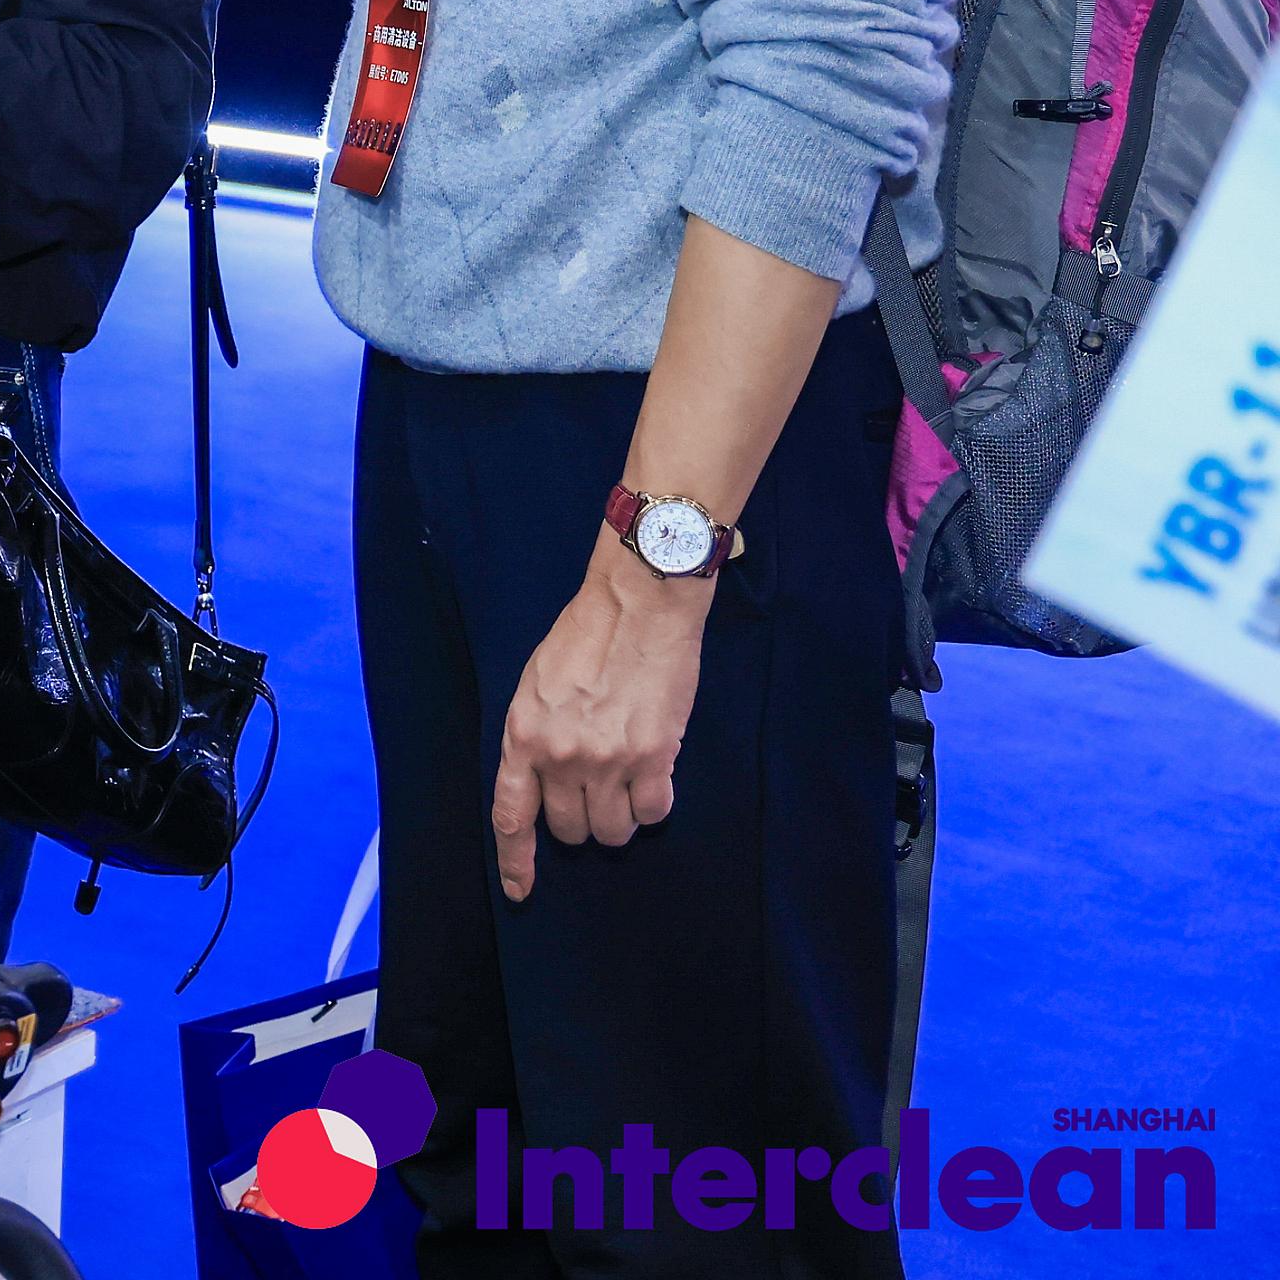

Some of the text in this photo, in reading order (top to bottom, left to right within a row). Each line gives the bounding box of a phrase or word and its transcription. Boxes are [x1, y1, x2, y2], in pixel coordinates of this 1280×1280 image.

[373, 24, 417, 50] 商用清洁设备
